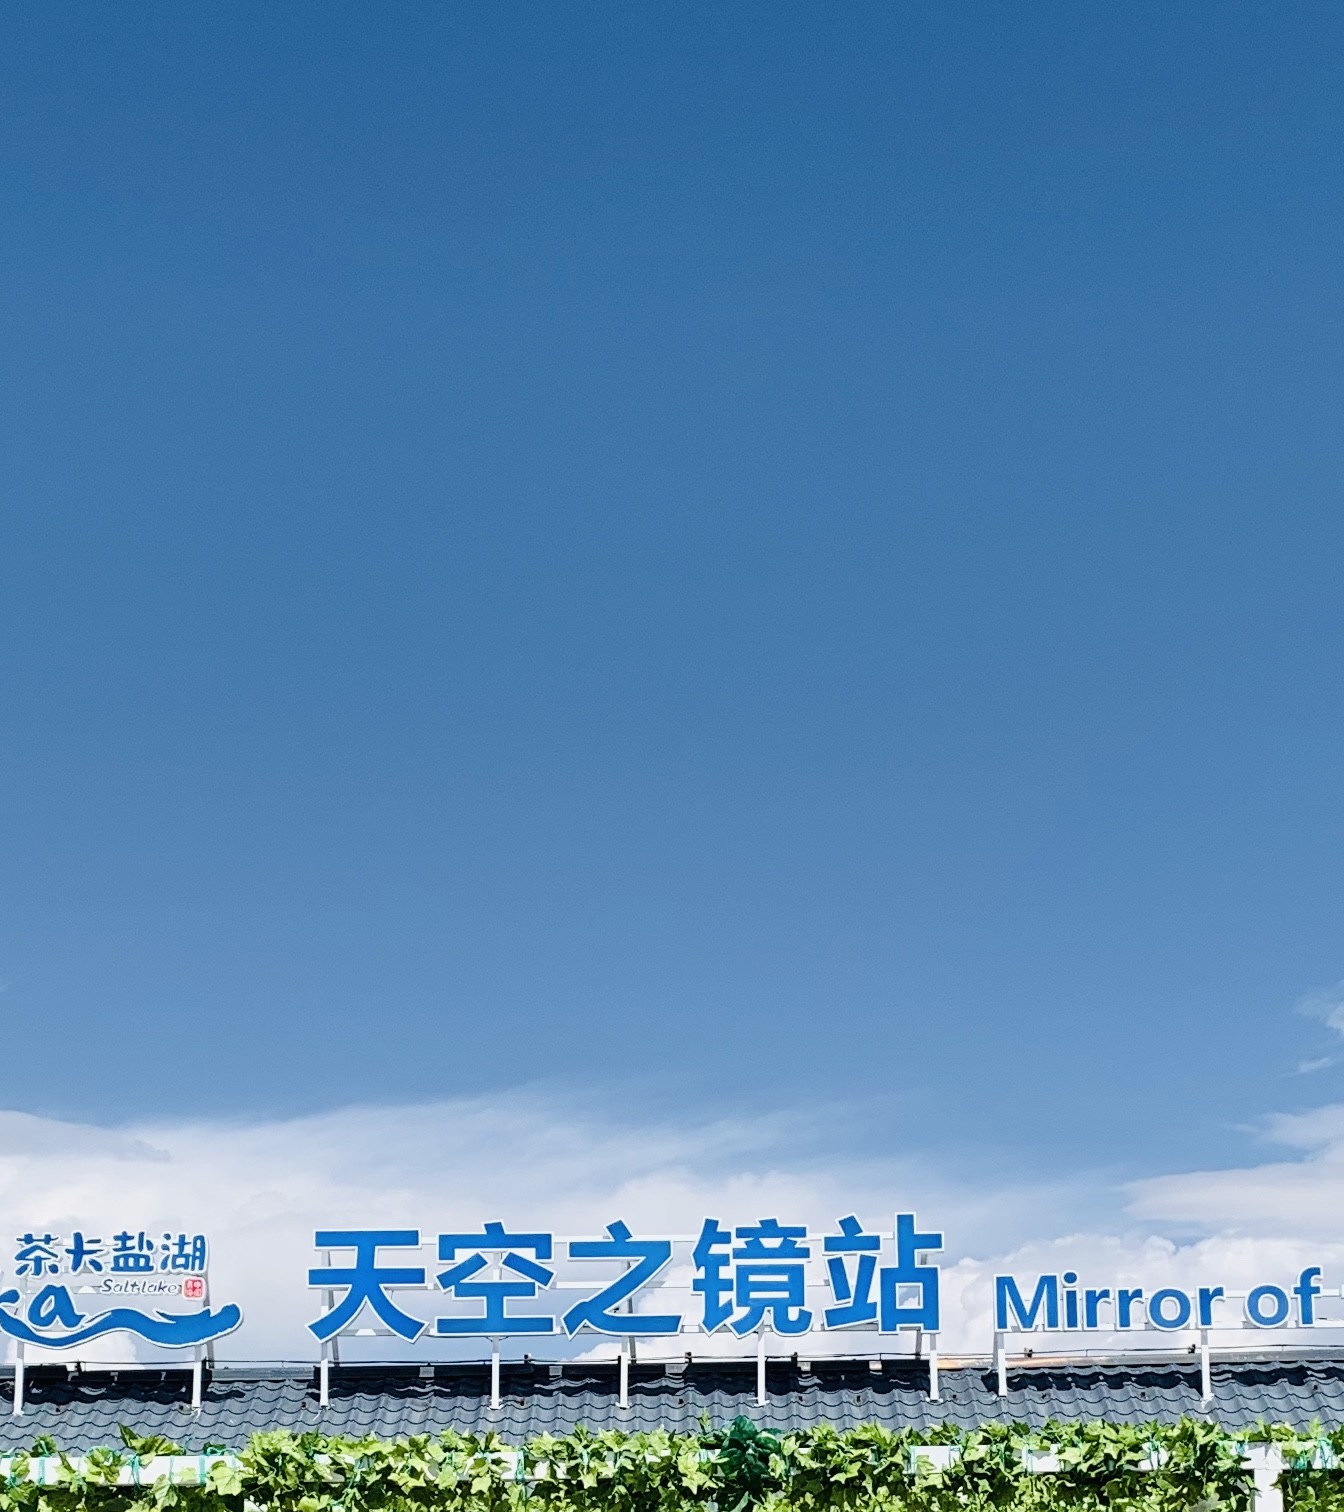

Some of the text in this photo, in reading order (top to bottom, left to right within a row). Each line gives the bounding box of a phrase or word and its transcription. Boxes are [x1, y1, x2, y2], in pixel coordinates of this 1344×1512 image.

[15, 1231, 205, 1275] 茶卡盐湖
[308, 1214, 943, 1340] 天空之镜站
[996, 1272, 1223, 1329] Mirror
[1248, 1267, 1321, 1326] of
